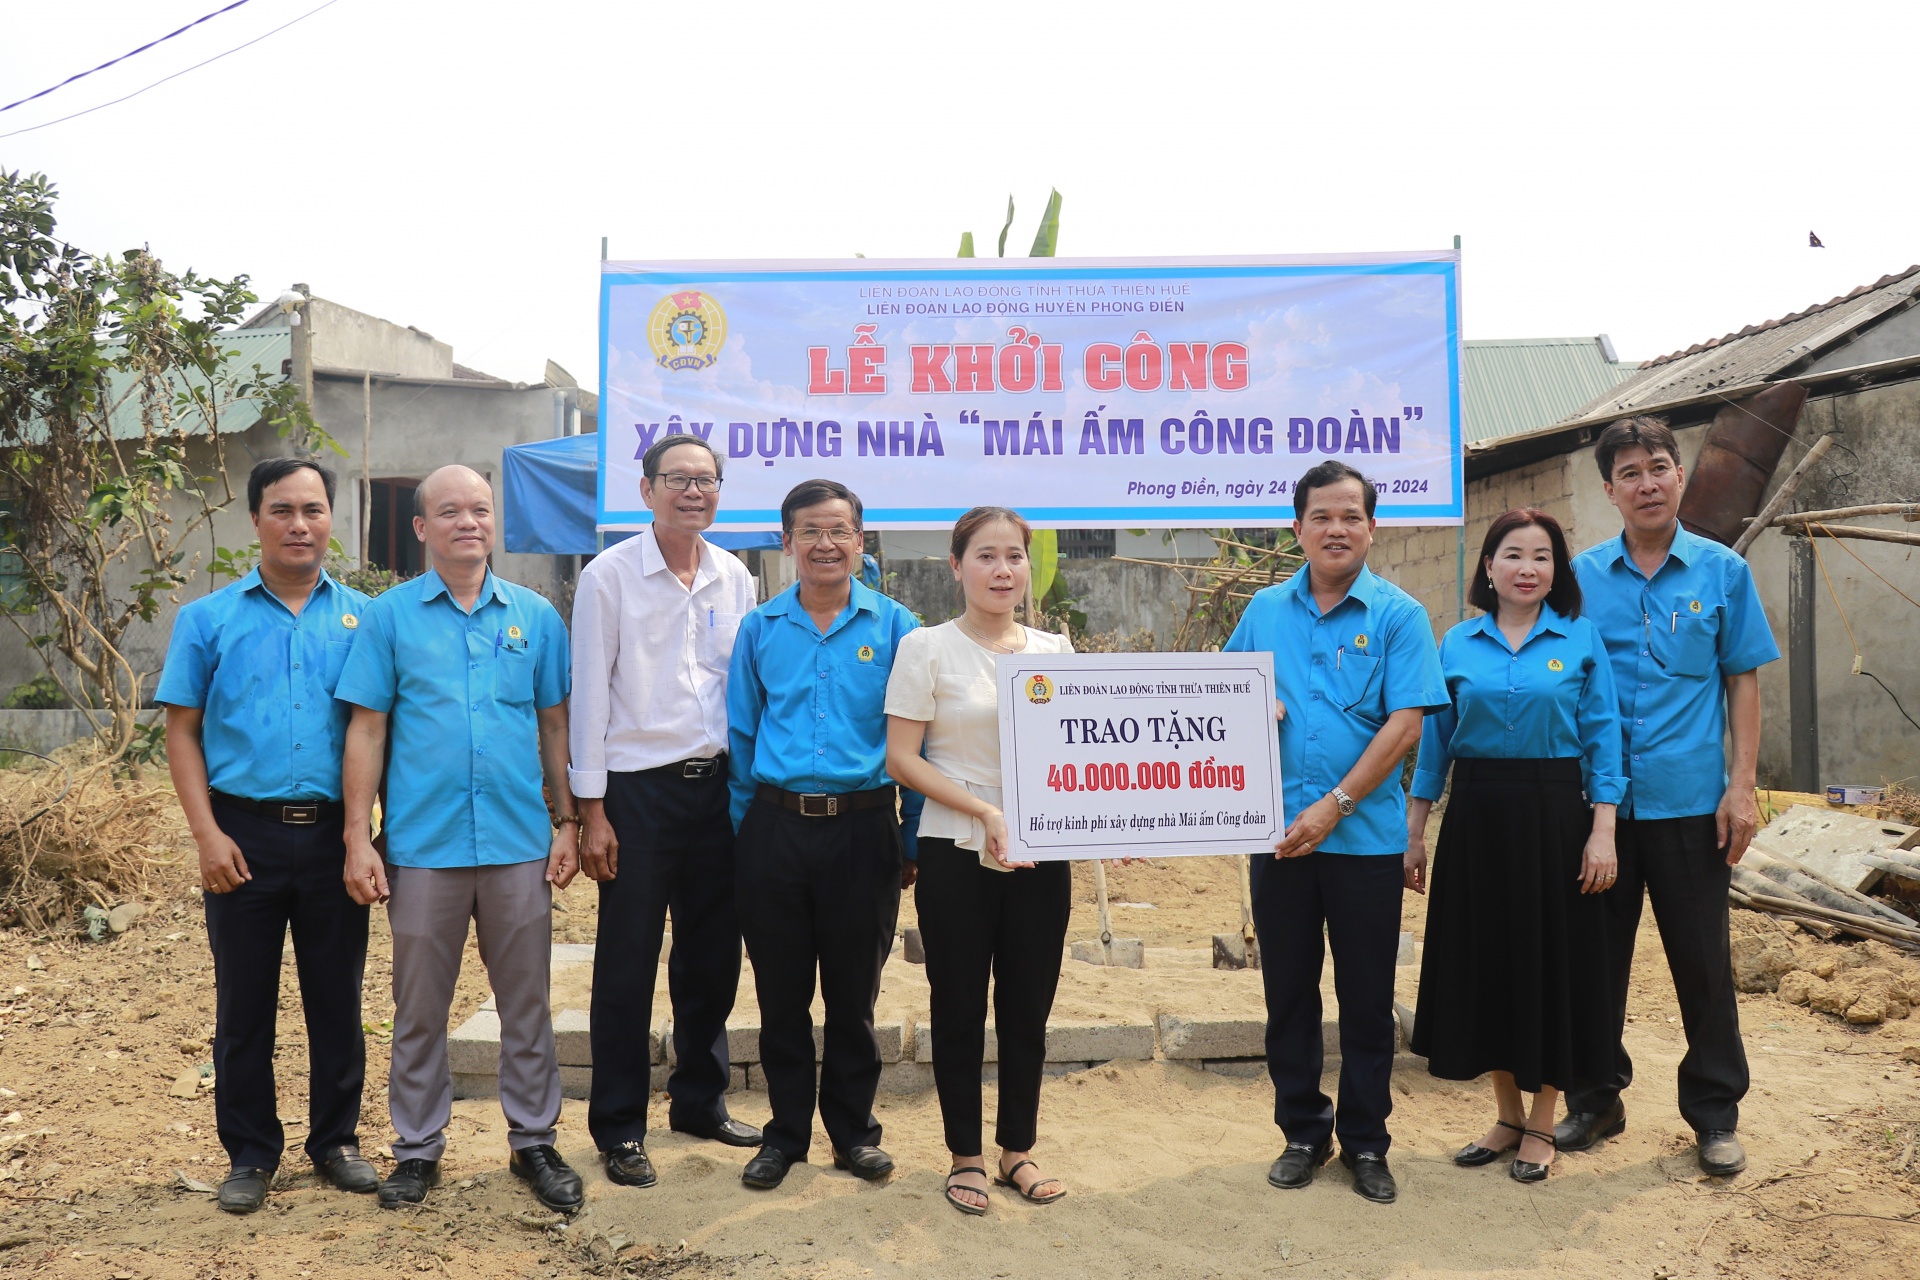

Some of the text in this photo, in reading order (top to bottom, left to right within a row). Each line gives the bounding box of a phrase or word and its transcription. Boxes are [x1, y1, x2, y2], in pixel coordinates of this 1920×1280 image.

[859, 281, 1191, 298] LIÊN ĐOÀN LAO ĐỘNG TỈNH THỪA THIÊN HUẾ
[867, 297, 1184, 316] LIÊN ĐOÀN LAO ĐỘNG HUYỆN PHONG ĐIỀN
[807, 322, 1250, 395] LỄ KHỞI CÔNG
[728, 416, 843, 467] DỰNG
[857, 412, 945, 457] NHÀ
[1078, 405, 1145, 455] ẤM
[1160, 409, 1274, 455] CÔNG
[1127, 480, 1176, 499] Phong
[1181, 477, 1219, 496] Điền,
[1225, 479, 1264, 499] ngày
[1269, 480, 1287, 494] 24
[1392, 479, 1429, 493] 2024
[1059, 680, 1251, 696] LIÊN ĐOÀN LAO ĐỘNG TỈNH THỪA THIÊN HUẾ
[1060, 709, 1227, 750] TRAO TẶNG
[1047, 756, 1245, 792] 40.000.000 đồng
[1029, 810, 1267, 834] Hỗ trợ kinh phí xây dựng nhà Mái ấm Công đoàn
